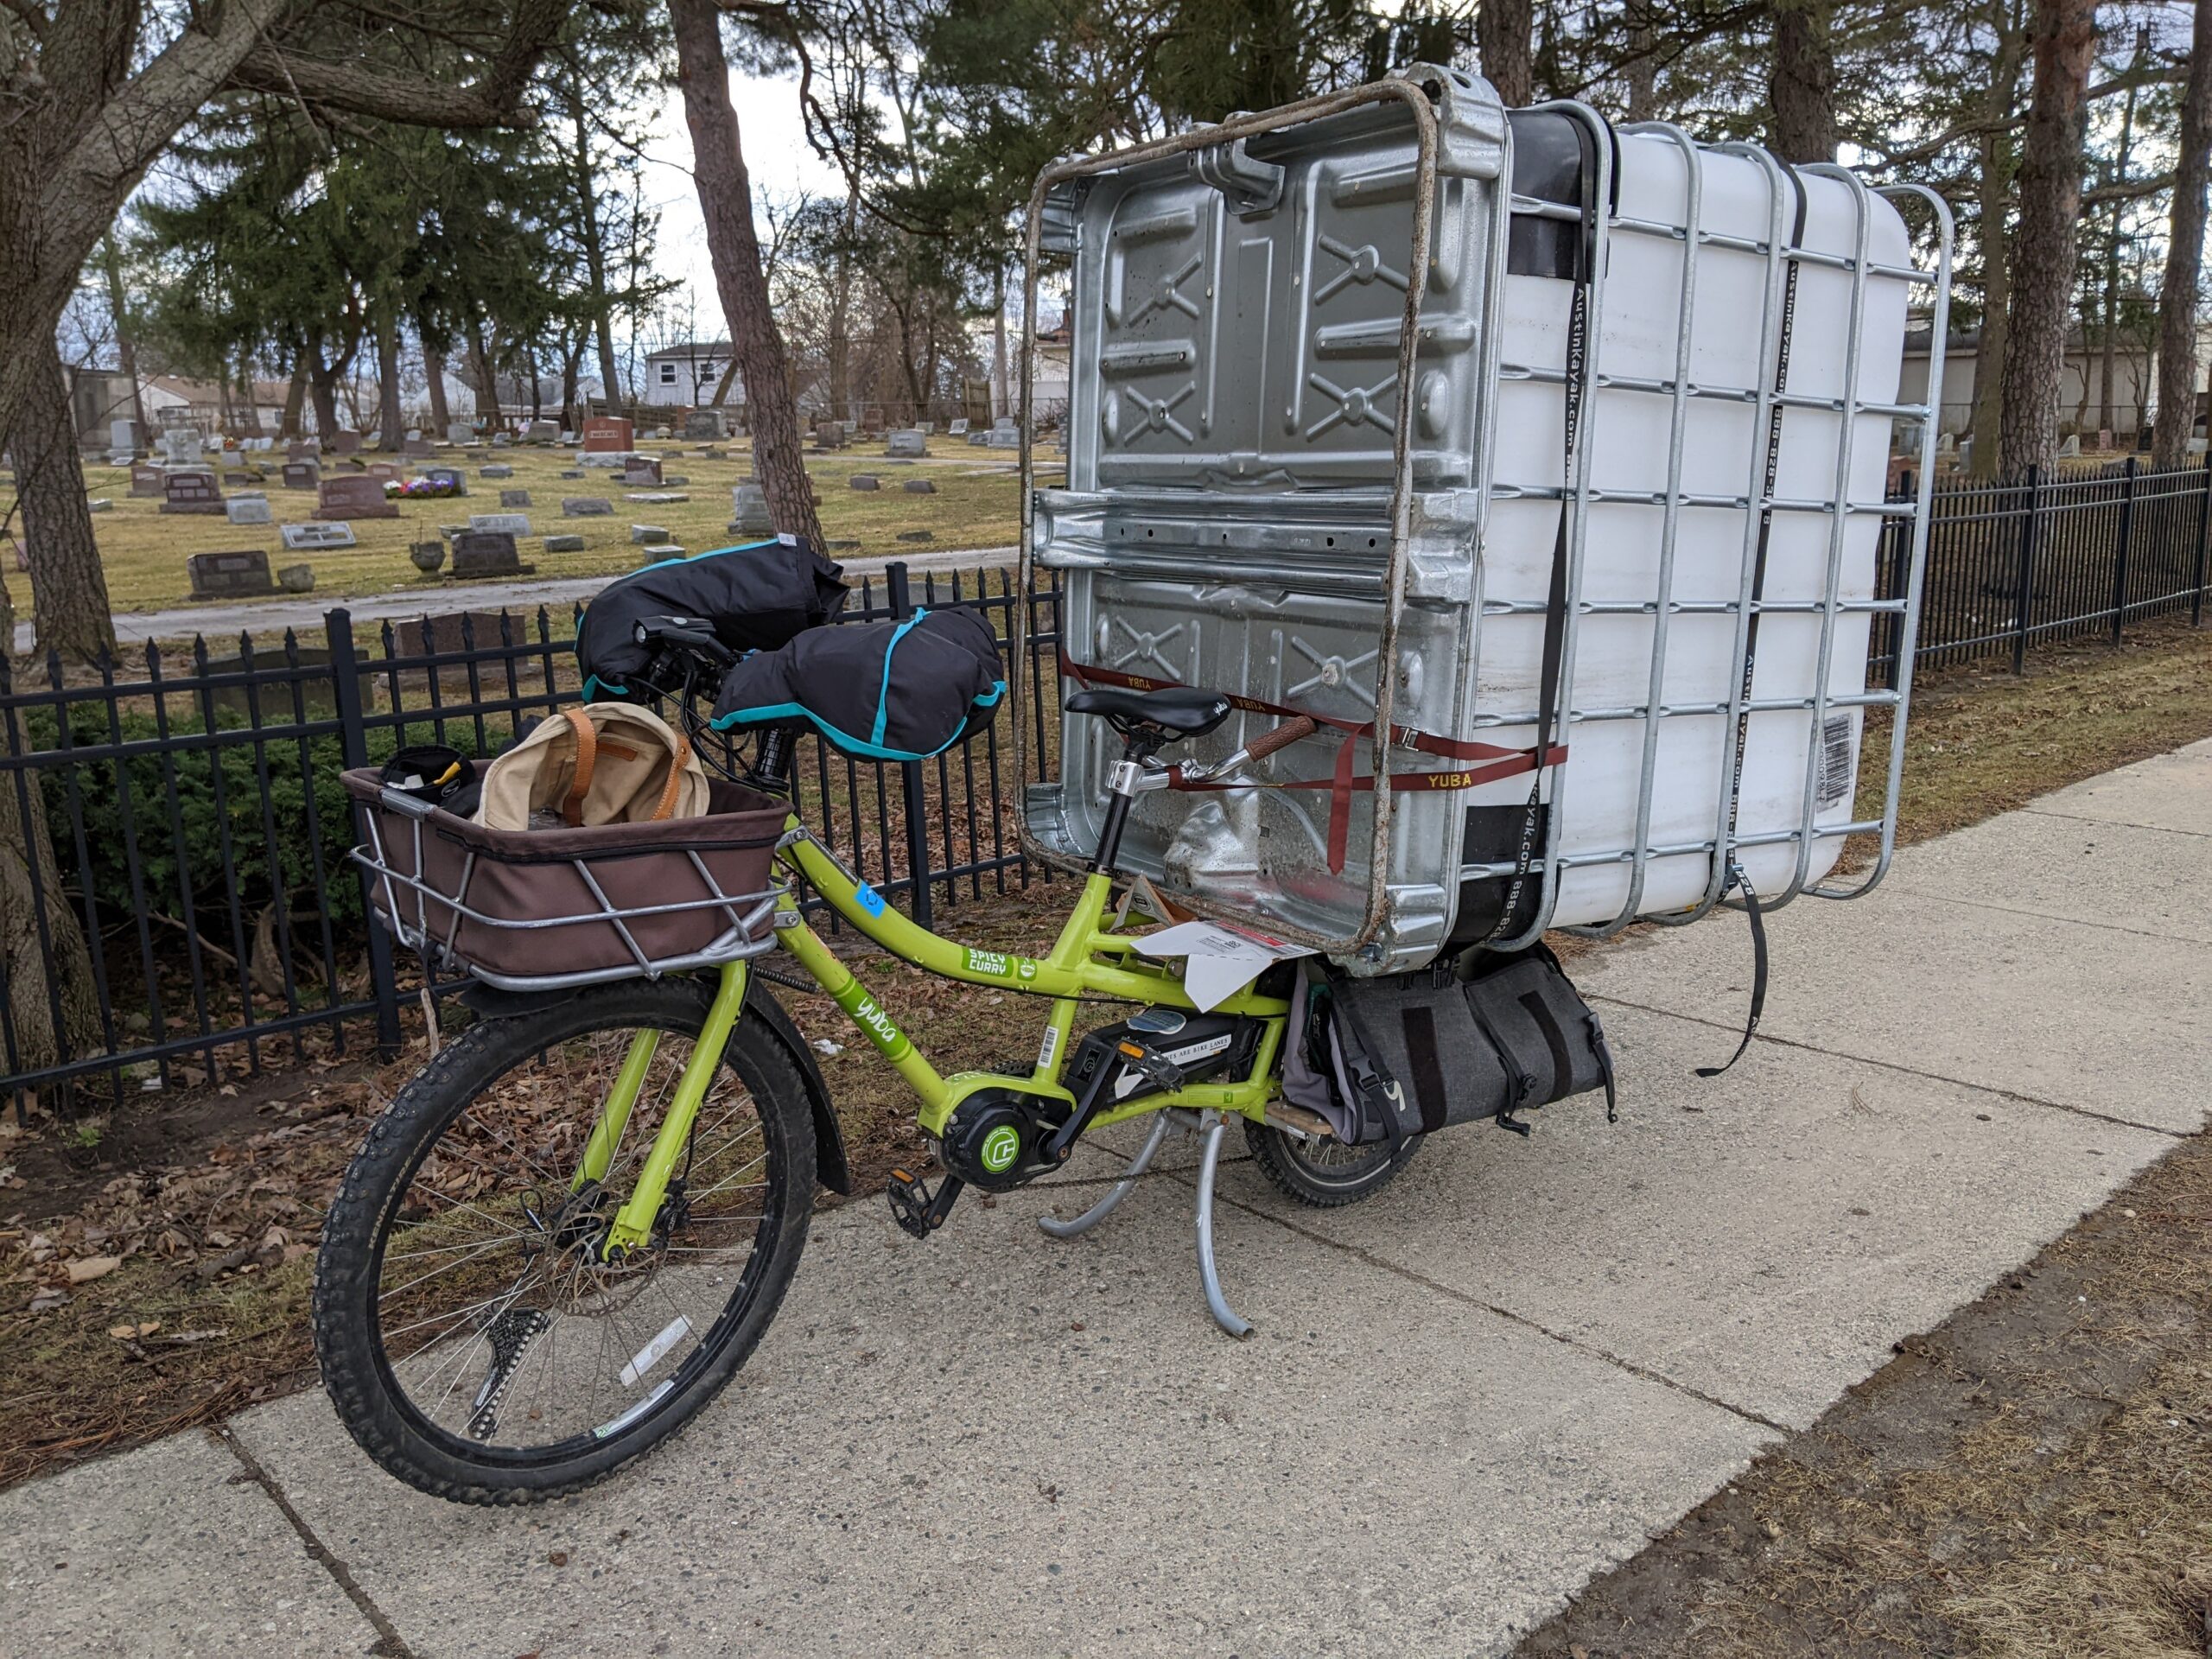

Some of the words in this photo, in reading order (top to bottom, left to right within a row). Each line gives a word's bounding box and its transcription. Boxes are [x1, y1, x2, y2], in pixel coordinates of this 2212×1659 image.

[1567, 288, 1585, 447] AustinKayak.com
[1764, 409, 1783, 524] 888-828-38
[1128, 676, 1152, 690] YUBA
[1236, 697, 1266, 712] YUBA
[1734, 654, 1754, 788] Austiayak.com
[1428, 772, 1471, 787] YUBA
[969, 948, 1006, 963] SPICY
[969, 959, 1007, 975] CURRY
[853, 996, 897, 1043] yuba
[1192, 1044, 1208, 1053] BIKE
[1210, 1038, 1228, 1048] LANES
